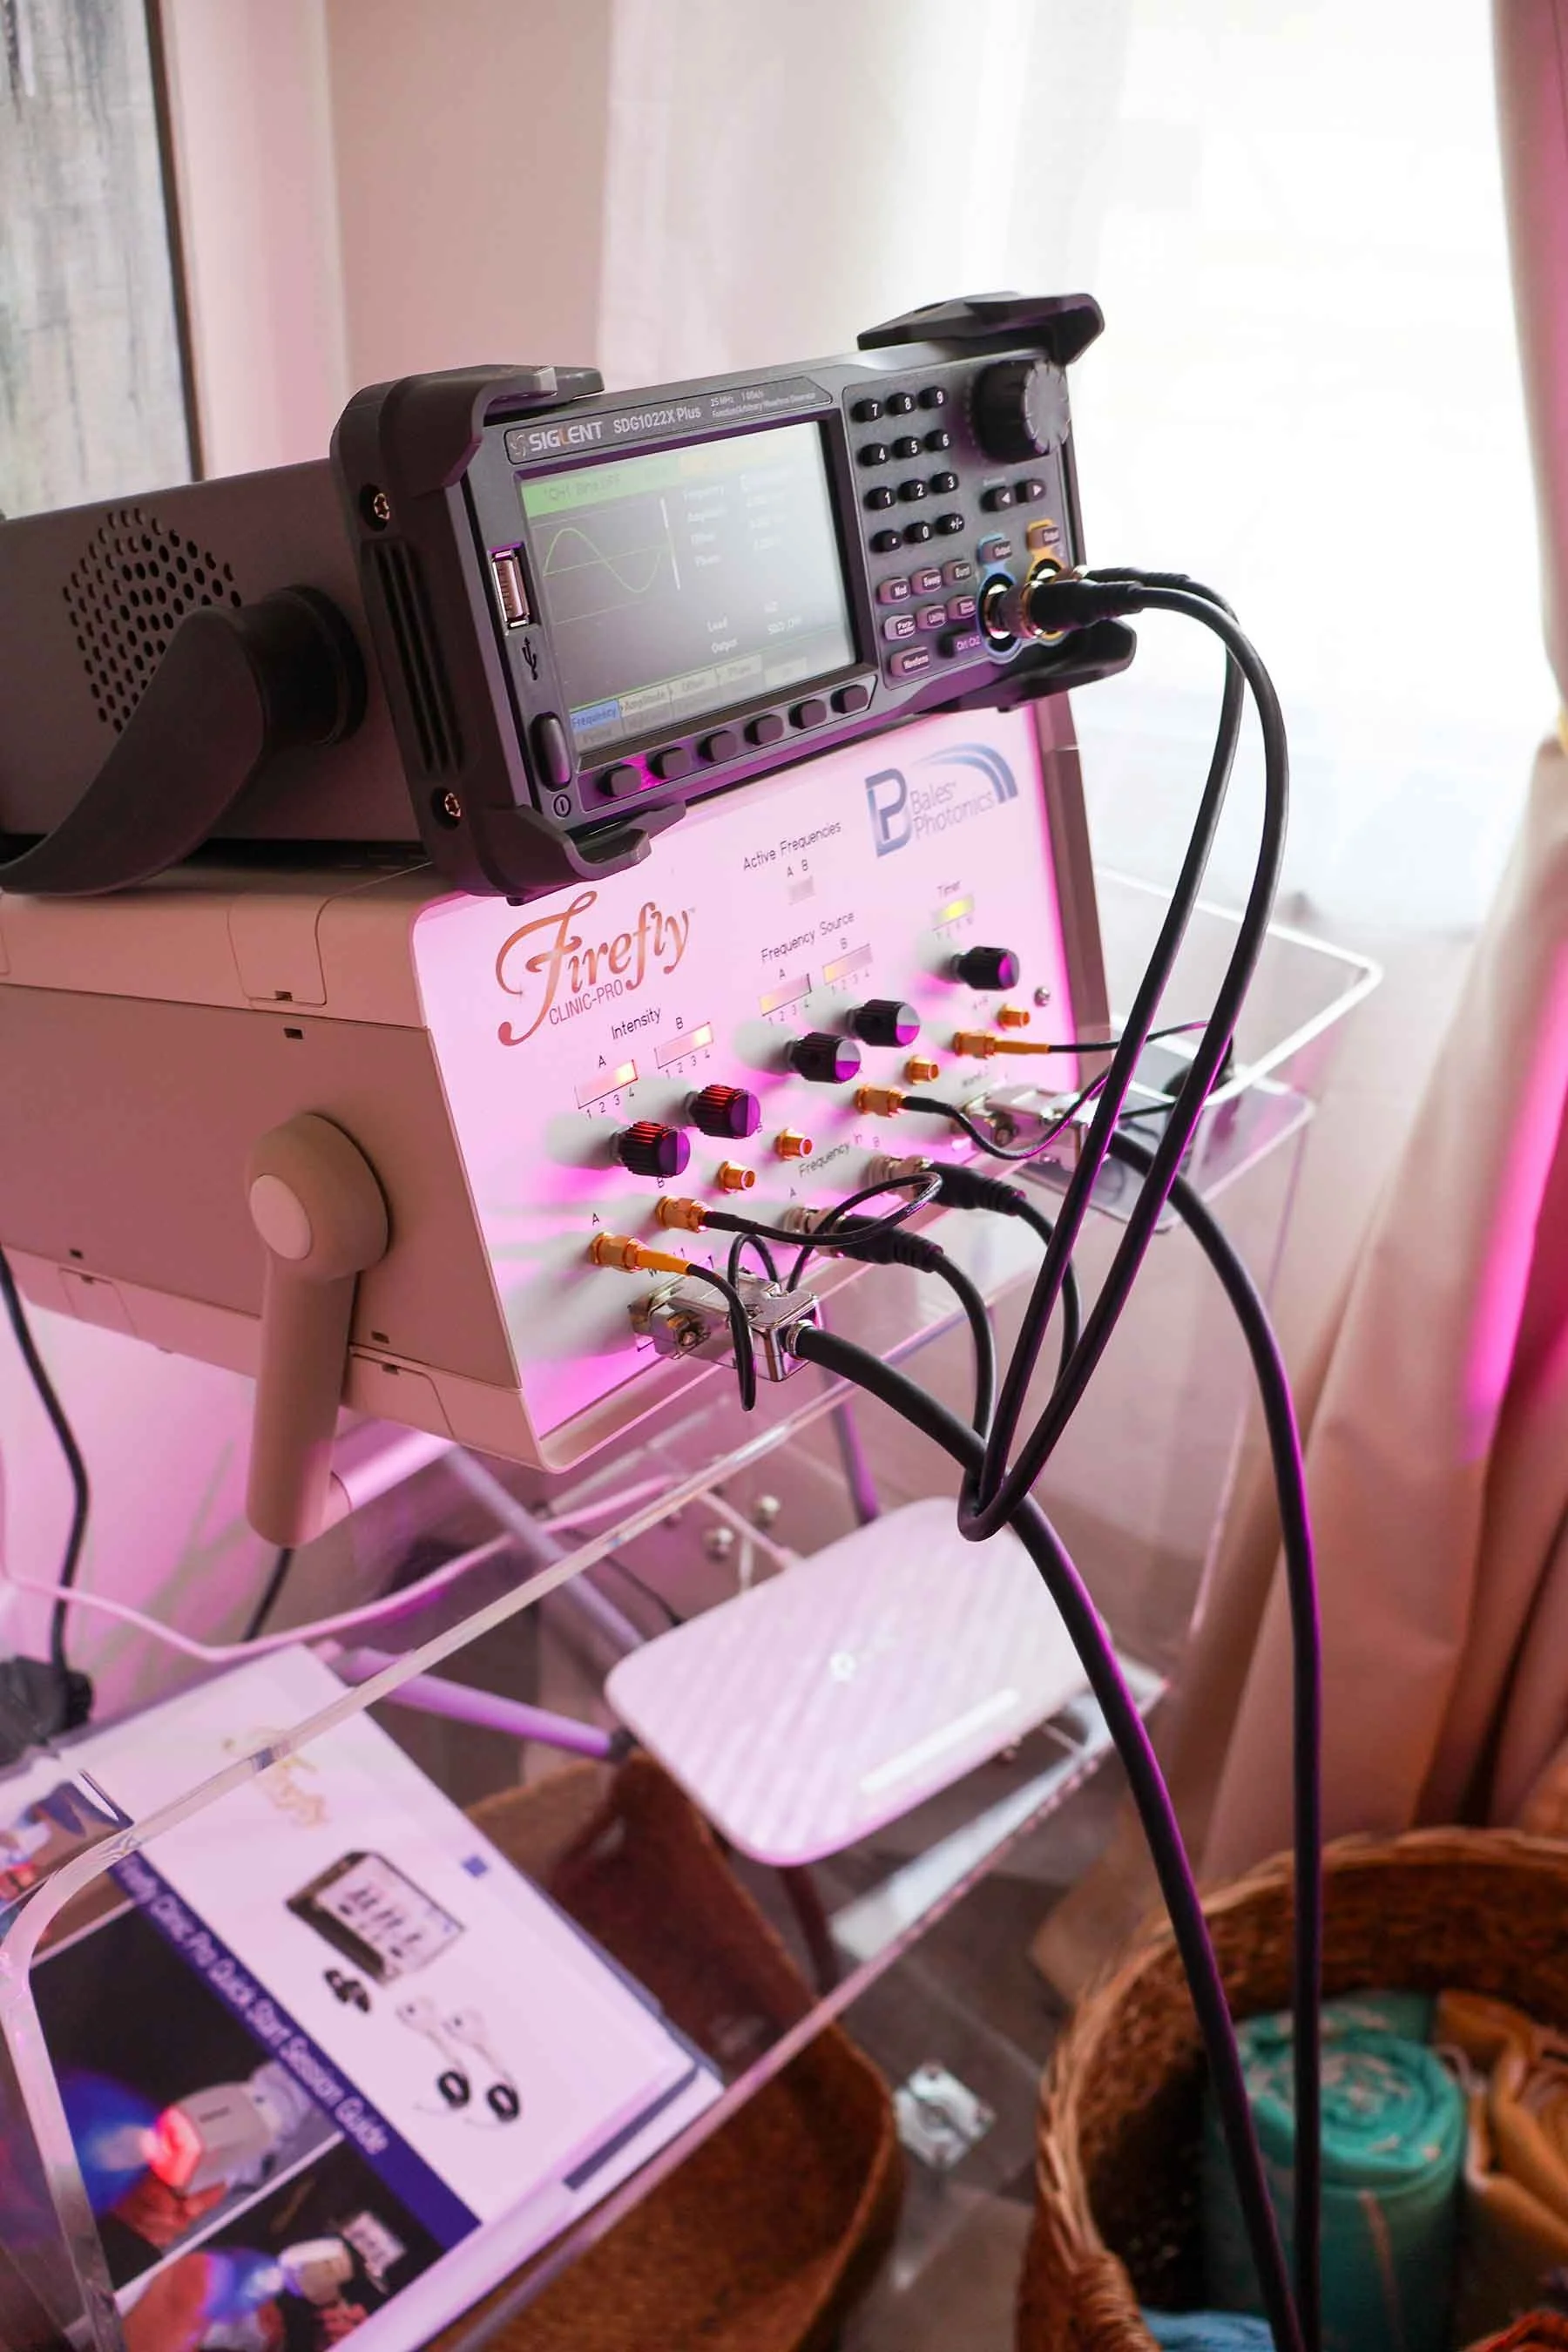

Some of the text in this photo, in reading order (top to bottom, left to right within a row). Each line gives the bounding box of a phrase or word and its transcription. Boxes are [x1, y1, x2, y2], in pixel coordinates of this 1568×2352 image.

[872, 390, 943, 417] 7 8 9
[613, 405, 702, 435] SDG1022X Plus
[529, 421, 603, 452] SIGLENT
[879, 434, 949, 461] 4 5 6
[885, 476, 955, 505] 1 2 3
[922, 525, 929, 538] 0
[913, 791, 996, 840] Photonics
[743, 821, 841, 871] Active Frequencies
[787, 859, 808, 877] A B
[760, 912, 855, 966] Frequency Source
[496, 890, 690, 1046] Firefly
[549, 978, 625, 1025] CLINIC-PRO
[612, 1007, 661, 1040] Intensity
[675, 1017, 684, 1030] B
[598, 1055, 606, 1068] A
[586, 1108, 592, 1120] 1
[598, 1101, 606, 1114] 2
[613, 1094, 620, 1106] 3
[798, 1141, 851, 1178] Frequency
[656, 1176, 665, 1189] B
[789, 1186, 797, 1199] A
[591, 1212, 600, 1226] A
